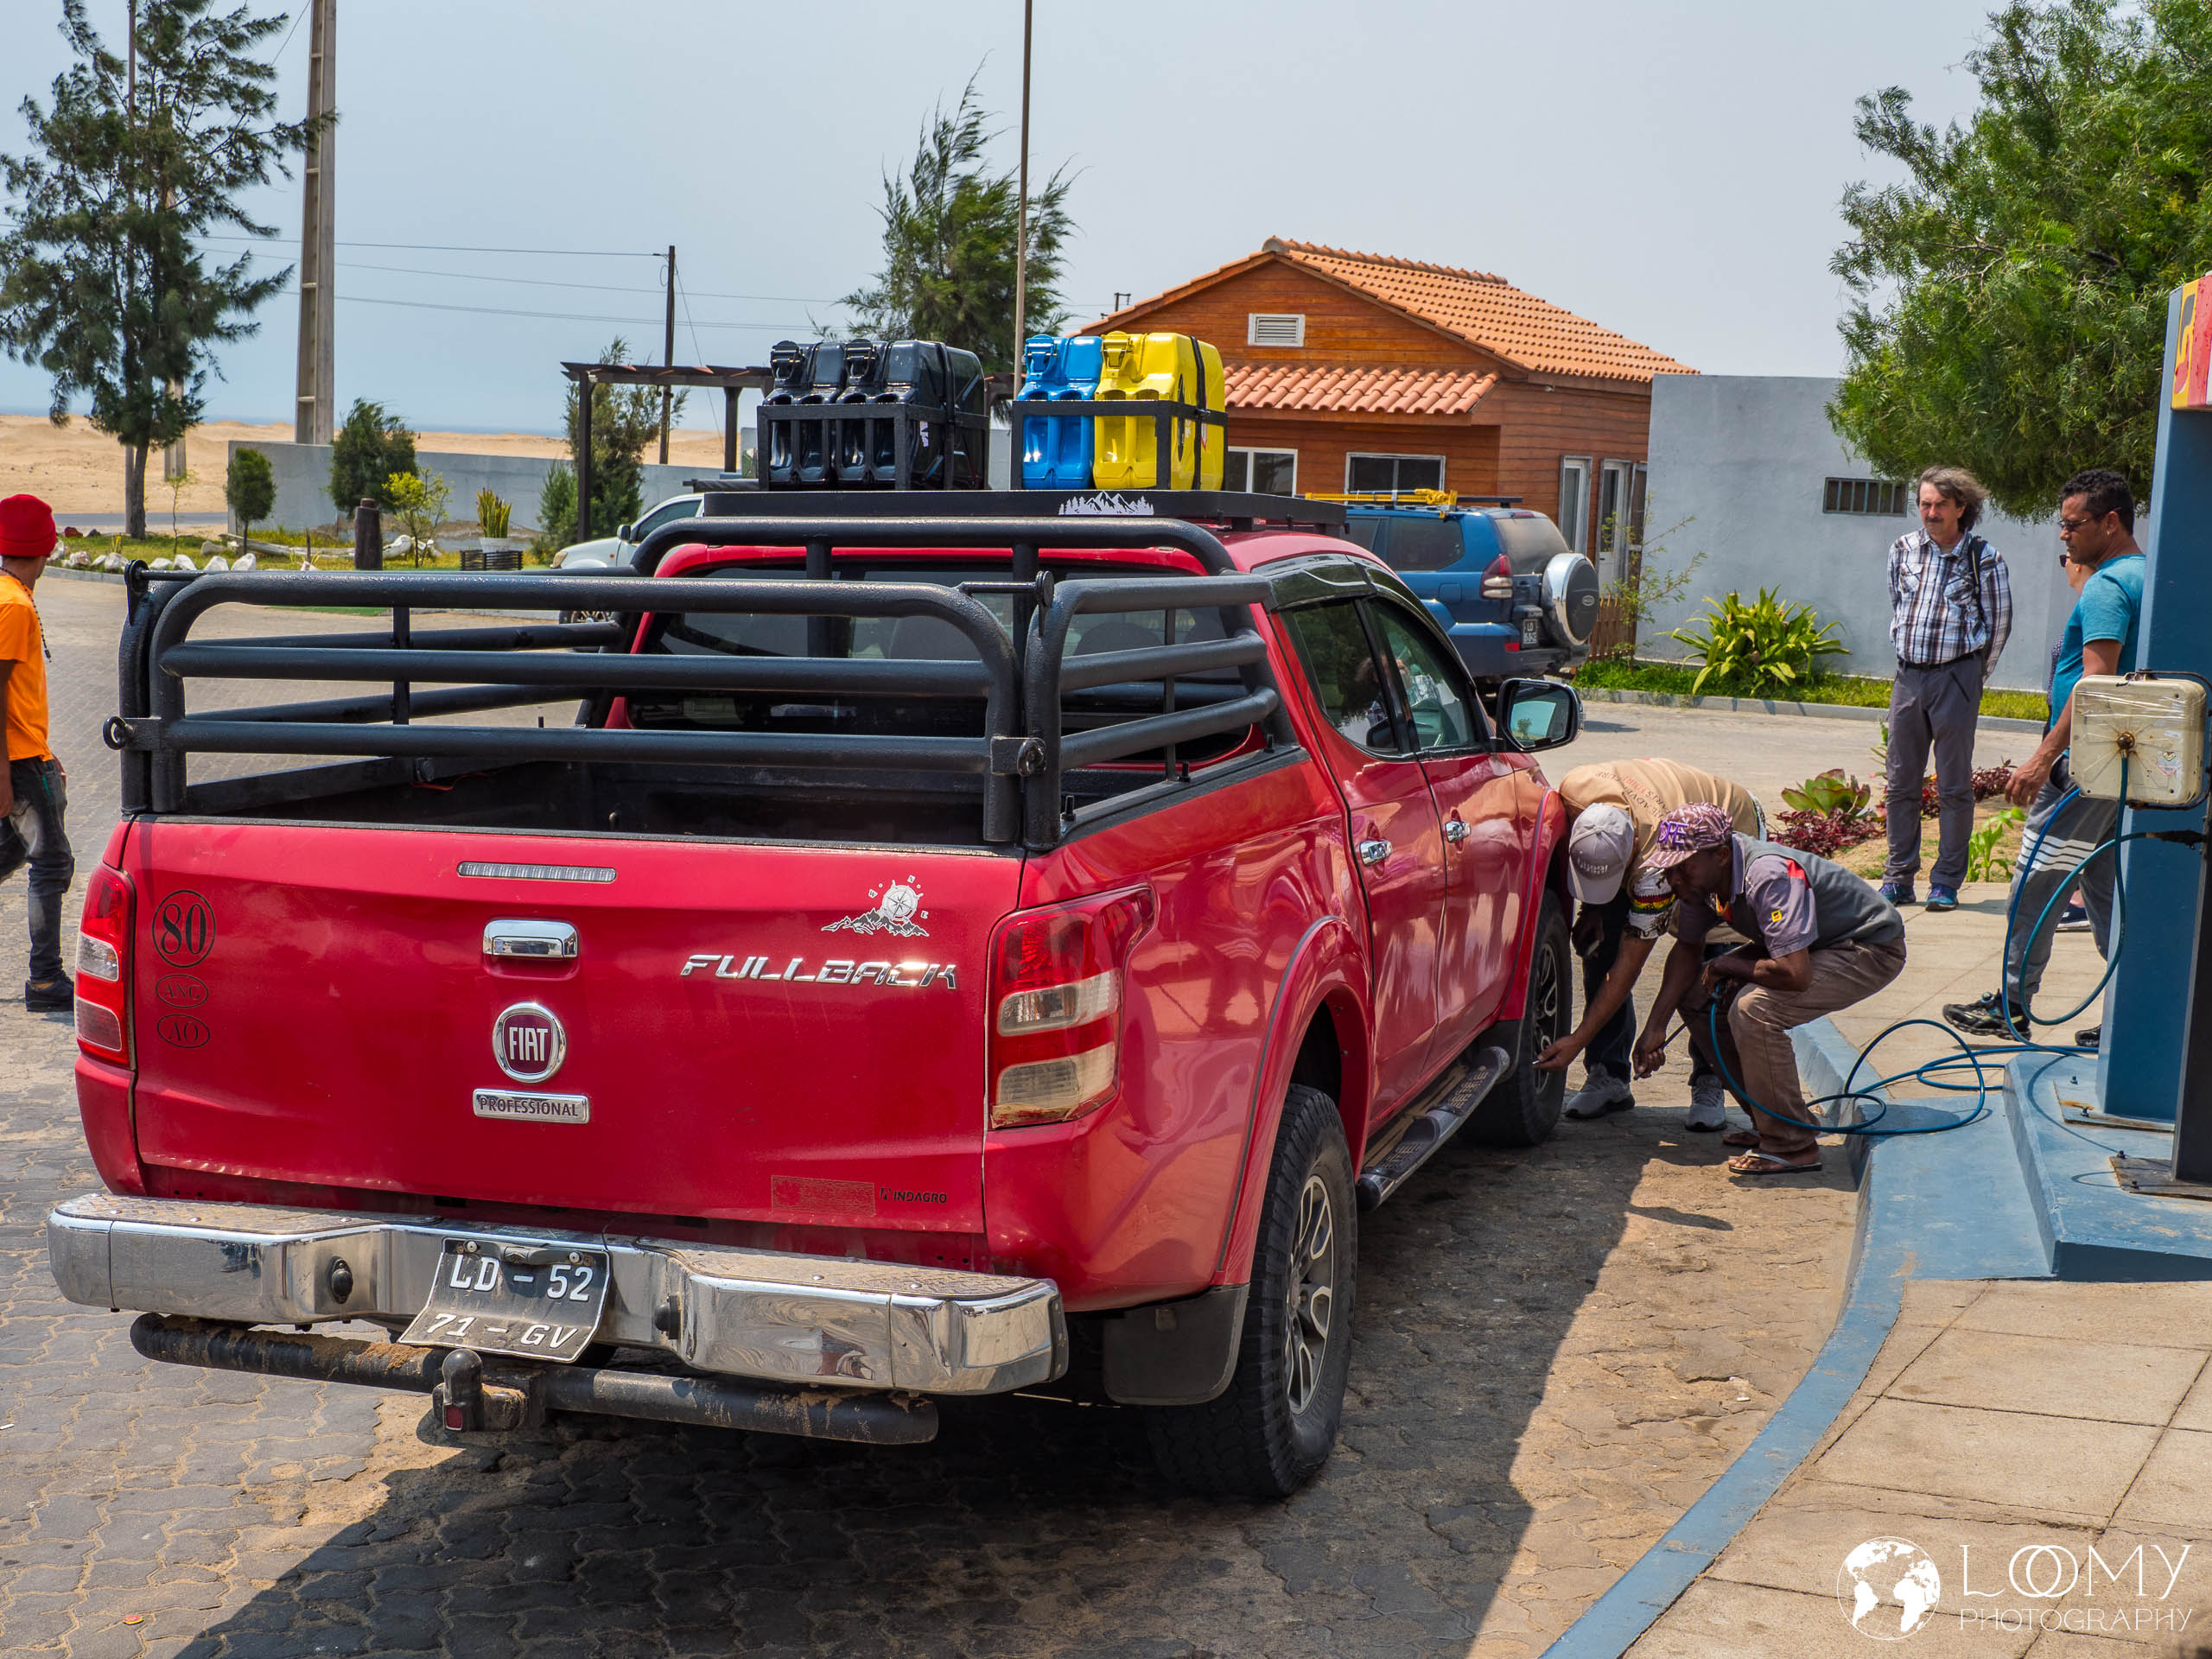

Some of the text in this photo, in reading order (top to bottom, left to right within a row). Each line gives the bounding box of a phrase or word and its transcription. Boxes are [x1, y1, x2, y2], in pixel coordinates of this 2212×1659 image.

[161, 903, 207, 955] 80
[680, 954, 957, 989] FULLBACK
[508, 1027, 549, 1062] FIAT
[480, 1096, 579, 1117] PROFESSIONAL
[893, 1191, 948, 1205] INDAGRO
